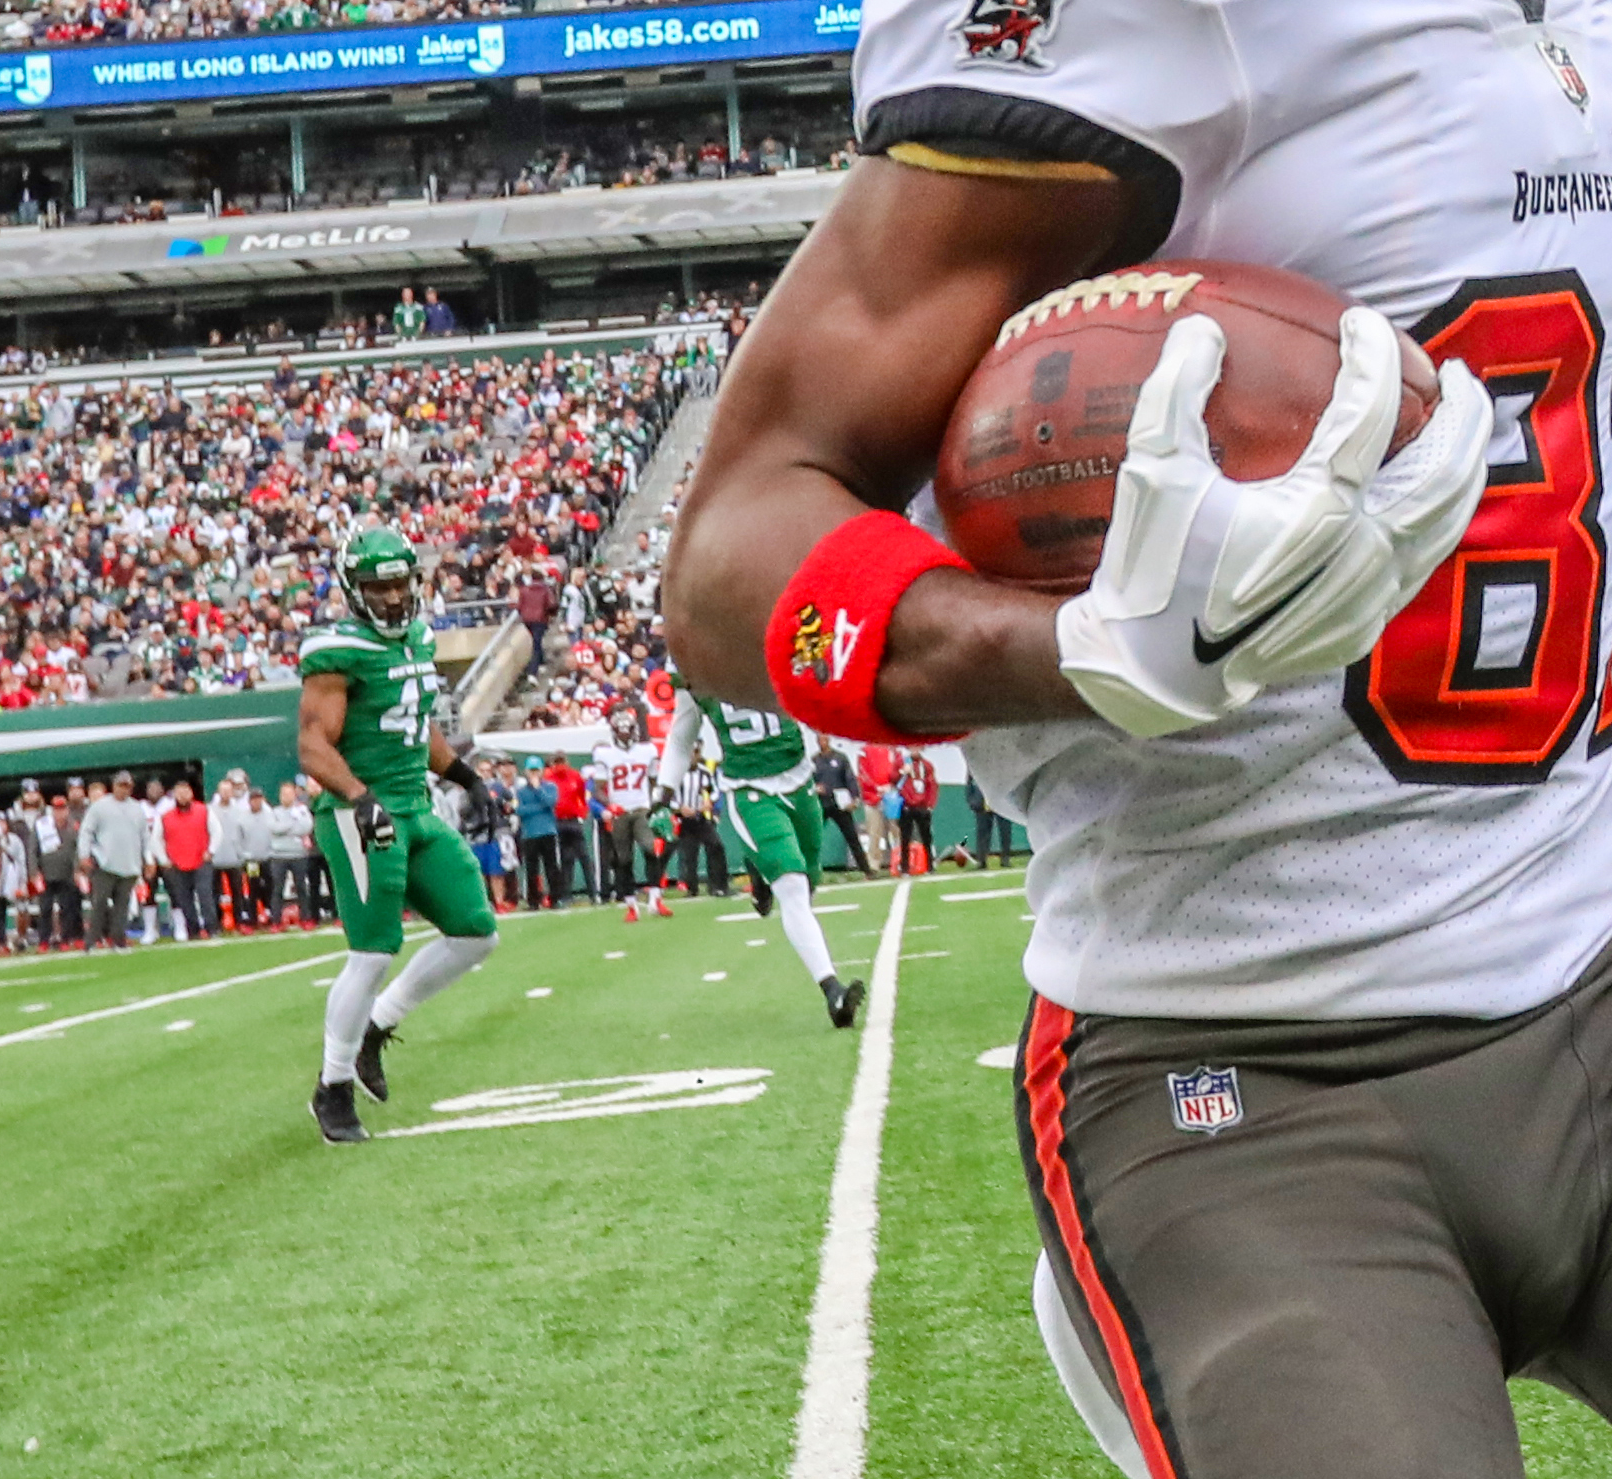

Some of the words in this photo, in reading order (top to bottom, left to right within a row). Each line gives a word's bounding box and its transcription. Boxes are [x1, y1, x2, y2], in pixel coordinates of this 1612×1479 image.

[815, 5, 862, 28] Jake
[564, 14, 760, 57] jakes58.com
[93, 61, 176, 85] WHERE
[181, 56, 244, 79] LONG
[250, 49, 333, 74] ISLAND
[339, 45, 406, 68] WINS!
[239, 225, 411, 254] MetLife
[1011, 456, 1116, 490] FOOTBALL
[612, 763, 647, 790] 27
[1184, 1095, 1234, 1124] NFL
